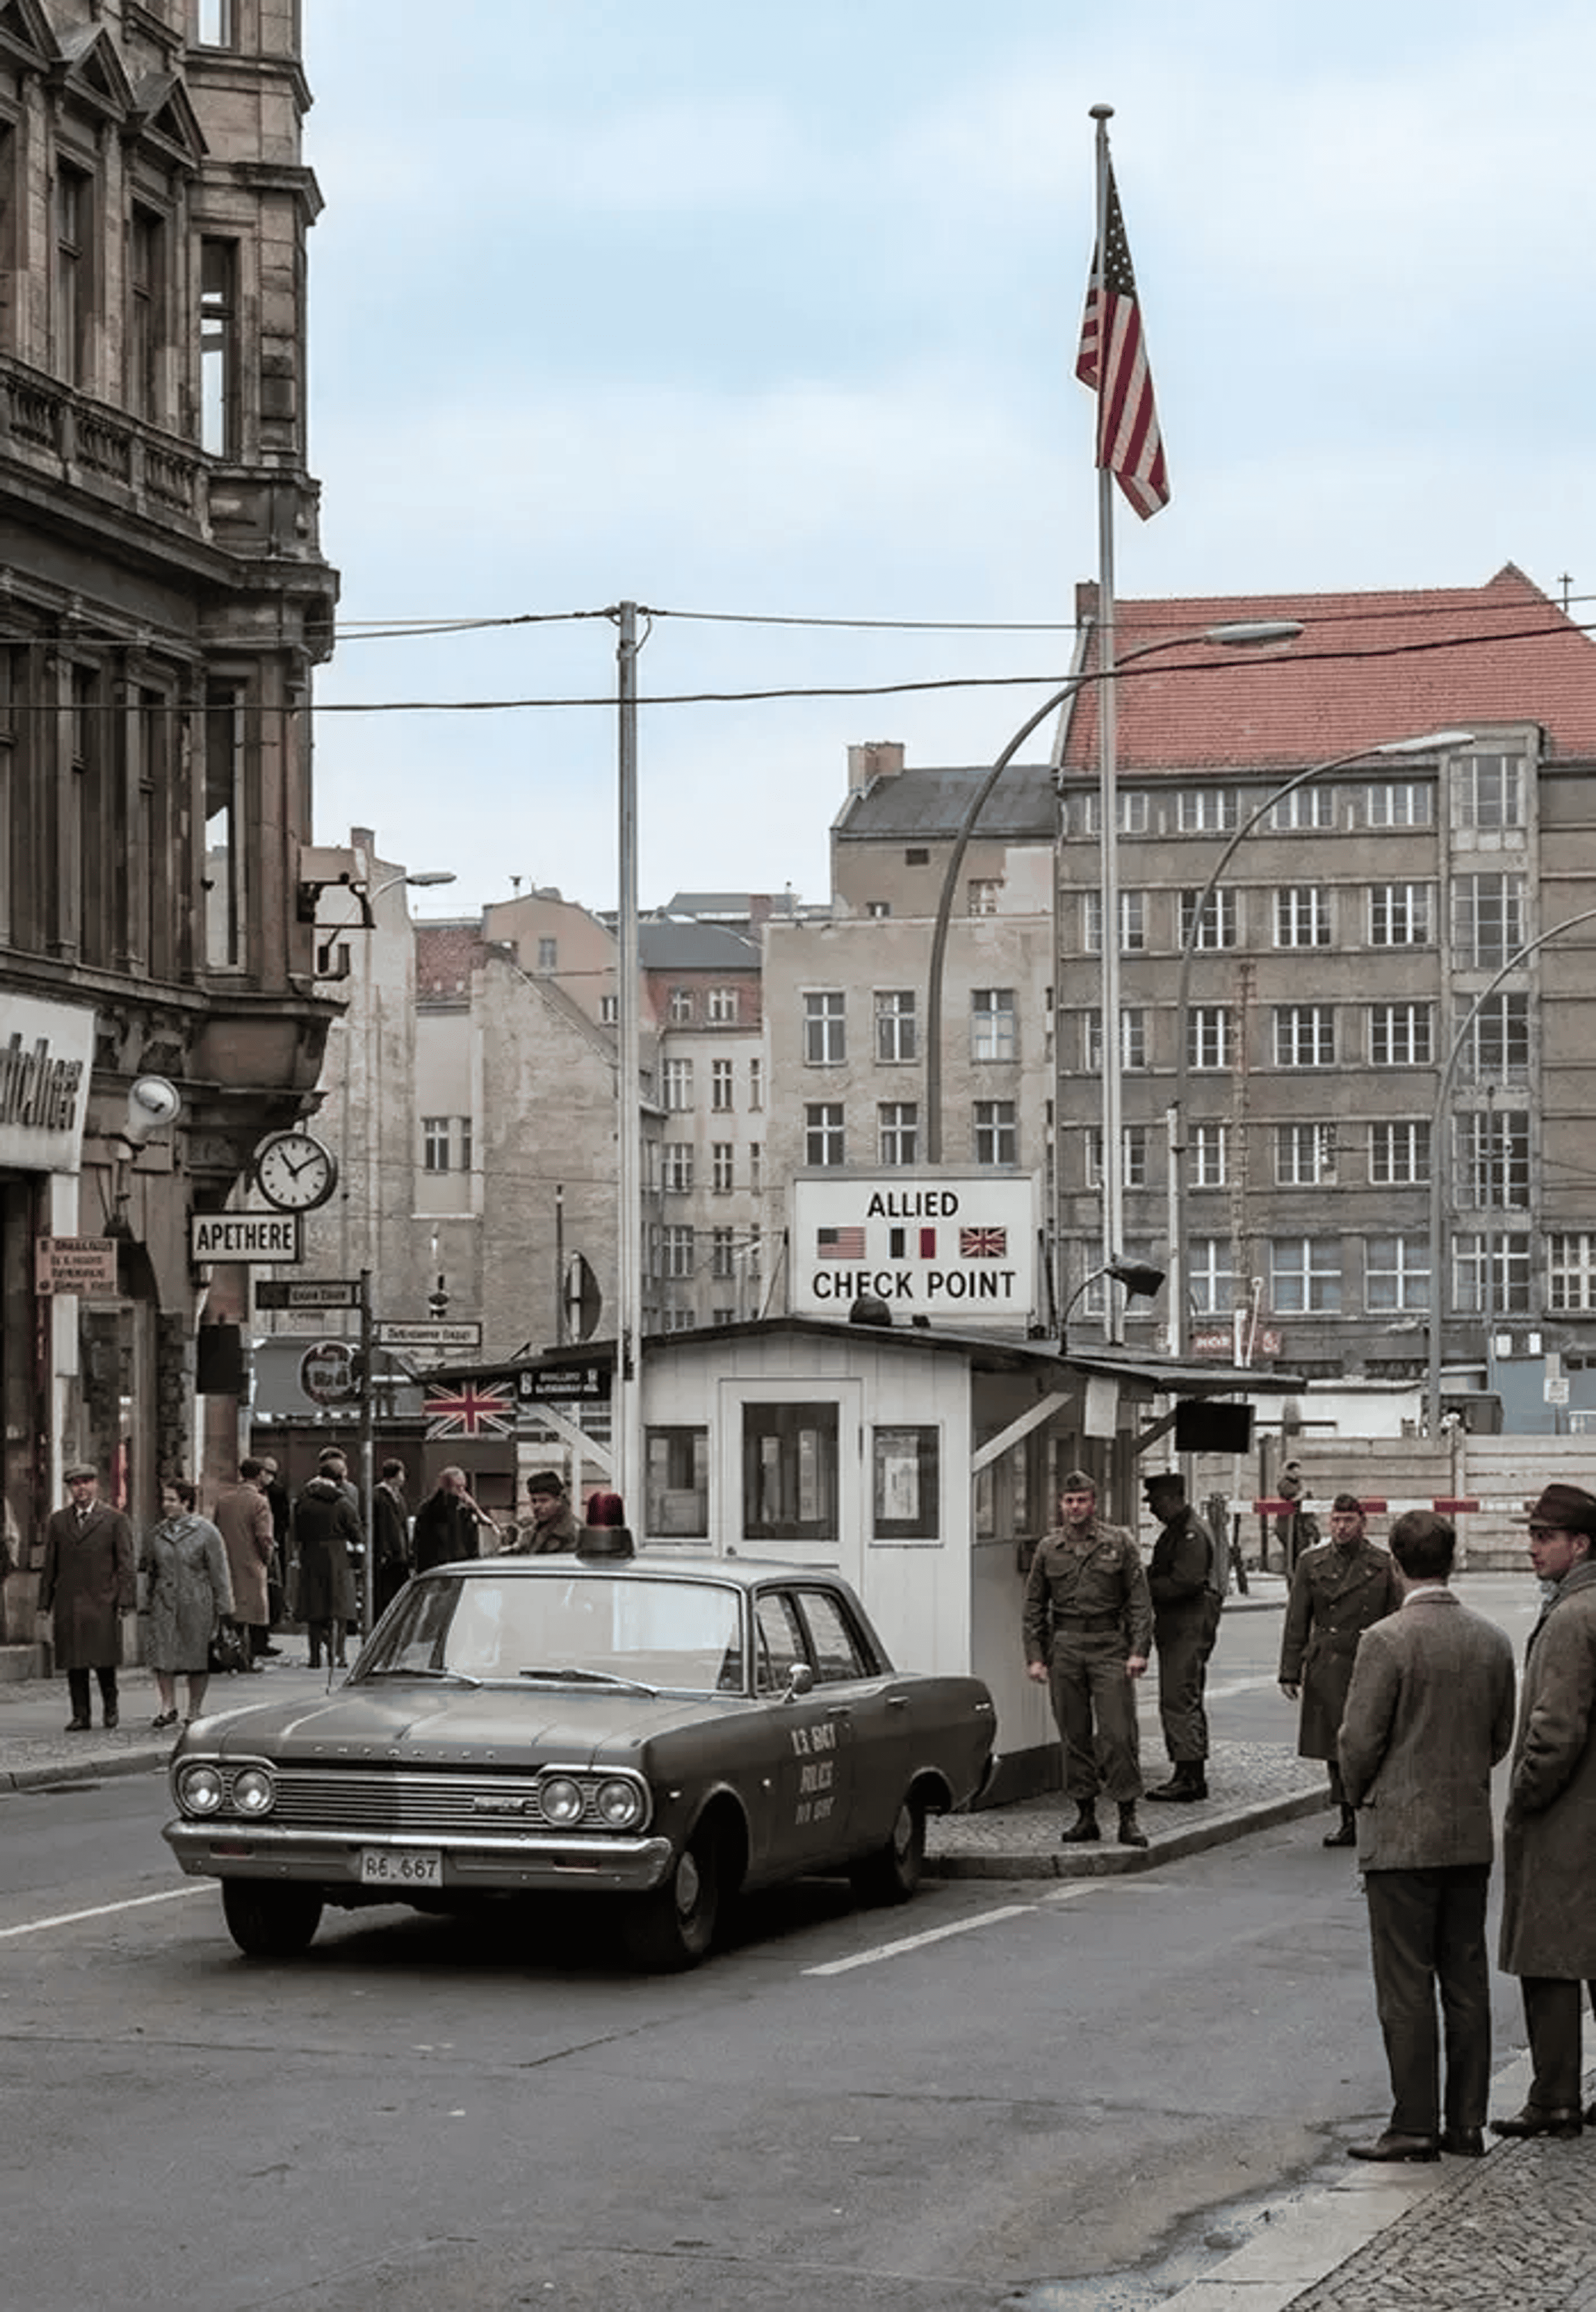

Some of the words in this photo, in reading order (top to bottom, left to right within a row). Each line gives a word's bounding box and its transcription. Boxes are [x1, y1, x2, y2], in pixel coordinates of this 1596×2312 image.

[867, 1191, 959, 1218] ALLIED
[813, 1271, 913, 1299] CHECK
[927, 1271, 1016, 1299] POINT
